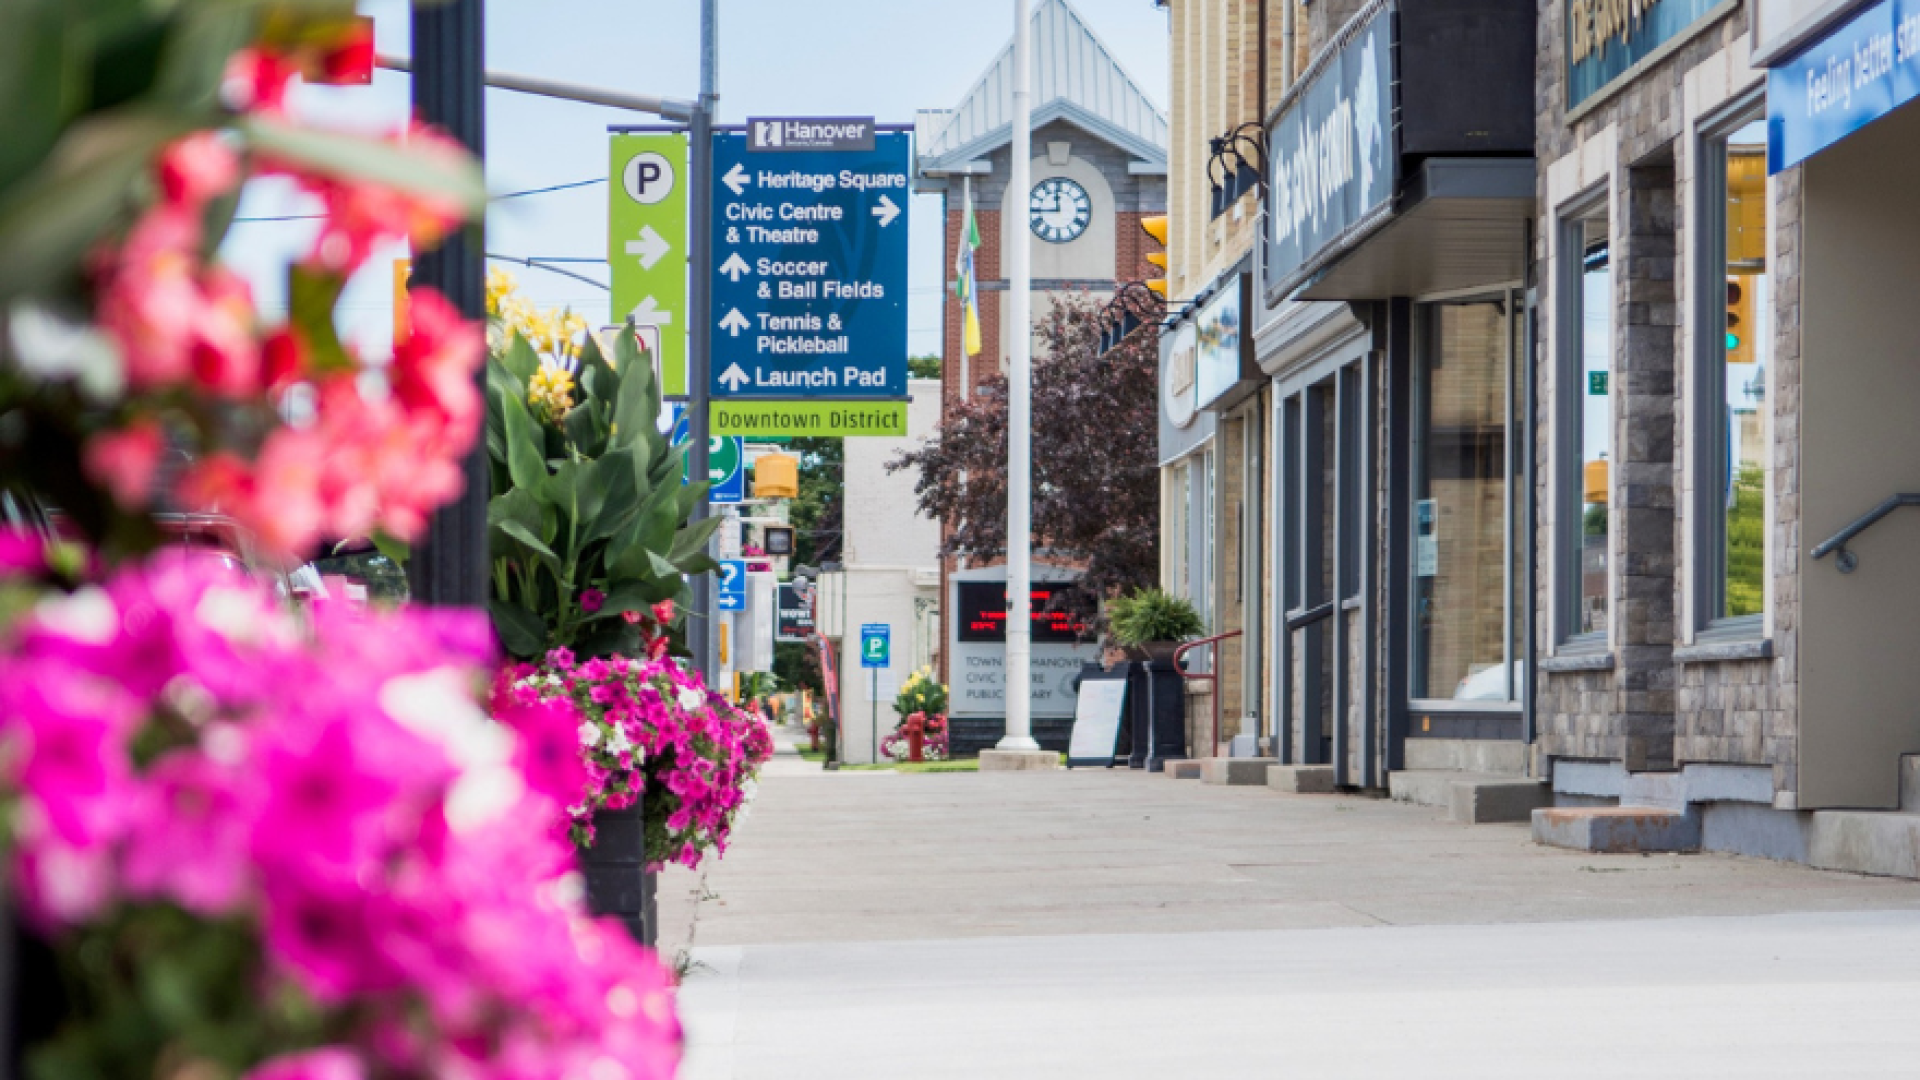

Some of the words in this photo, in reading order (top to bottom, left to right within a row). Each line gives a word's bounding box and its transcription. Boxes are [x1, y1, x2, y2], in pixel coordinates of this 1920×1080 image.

[1806, 53, 1850, 118] Feeling
[1853, 32, 1892, 90] better
[784, 121, 867, 139] Hanover
[637, 162, 662, 195] P
[757, 169, 836, 192] Heritage
[838, 169, 906, 192] Square
[725, 202, 774, 221] Civic
[778, 202, 843, 221] Centre
[725, 226, 741, 243] &
[745, 226, 819, 243] Theatre
[756, 257, 829, 276] Soccer
[756, 281, 771, 299] &
[778, 281, 817, 299] Ball
[822, 281, 885, 299] Fields
[756, 312, 822, 330] Tennis
[826, 313, 843, 330] &
[756, 336, 849, 354] Pickleball
[755, 367, 837, 387] Launch
[843, 367, 887, 387] Pad
[718, 411, 821, 428] Downtown
[829, 410, 900, 428] District
[870, 637, 882, 652] P
[966, 656, 1003, 667] TOWN
[966, 672, 997, 684] CIVIC
[966, 689, 1003, 699] PUBLIC
